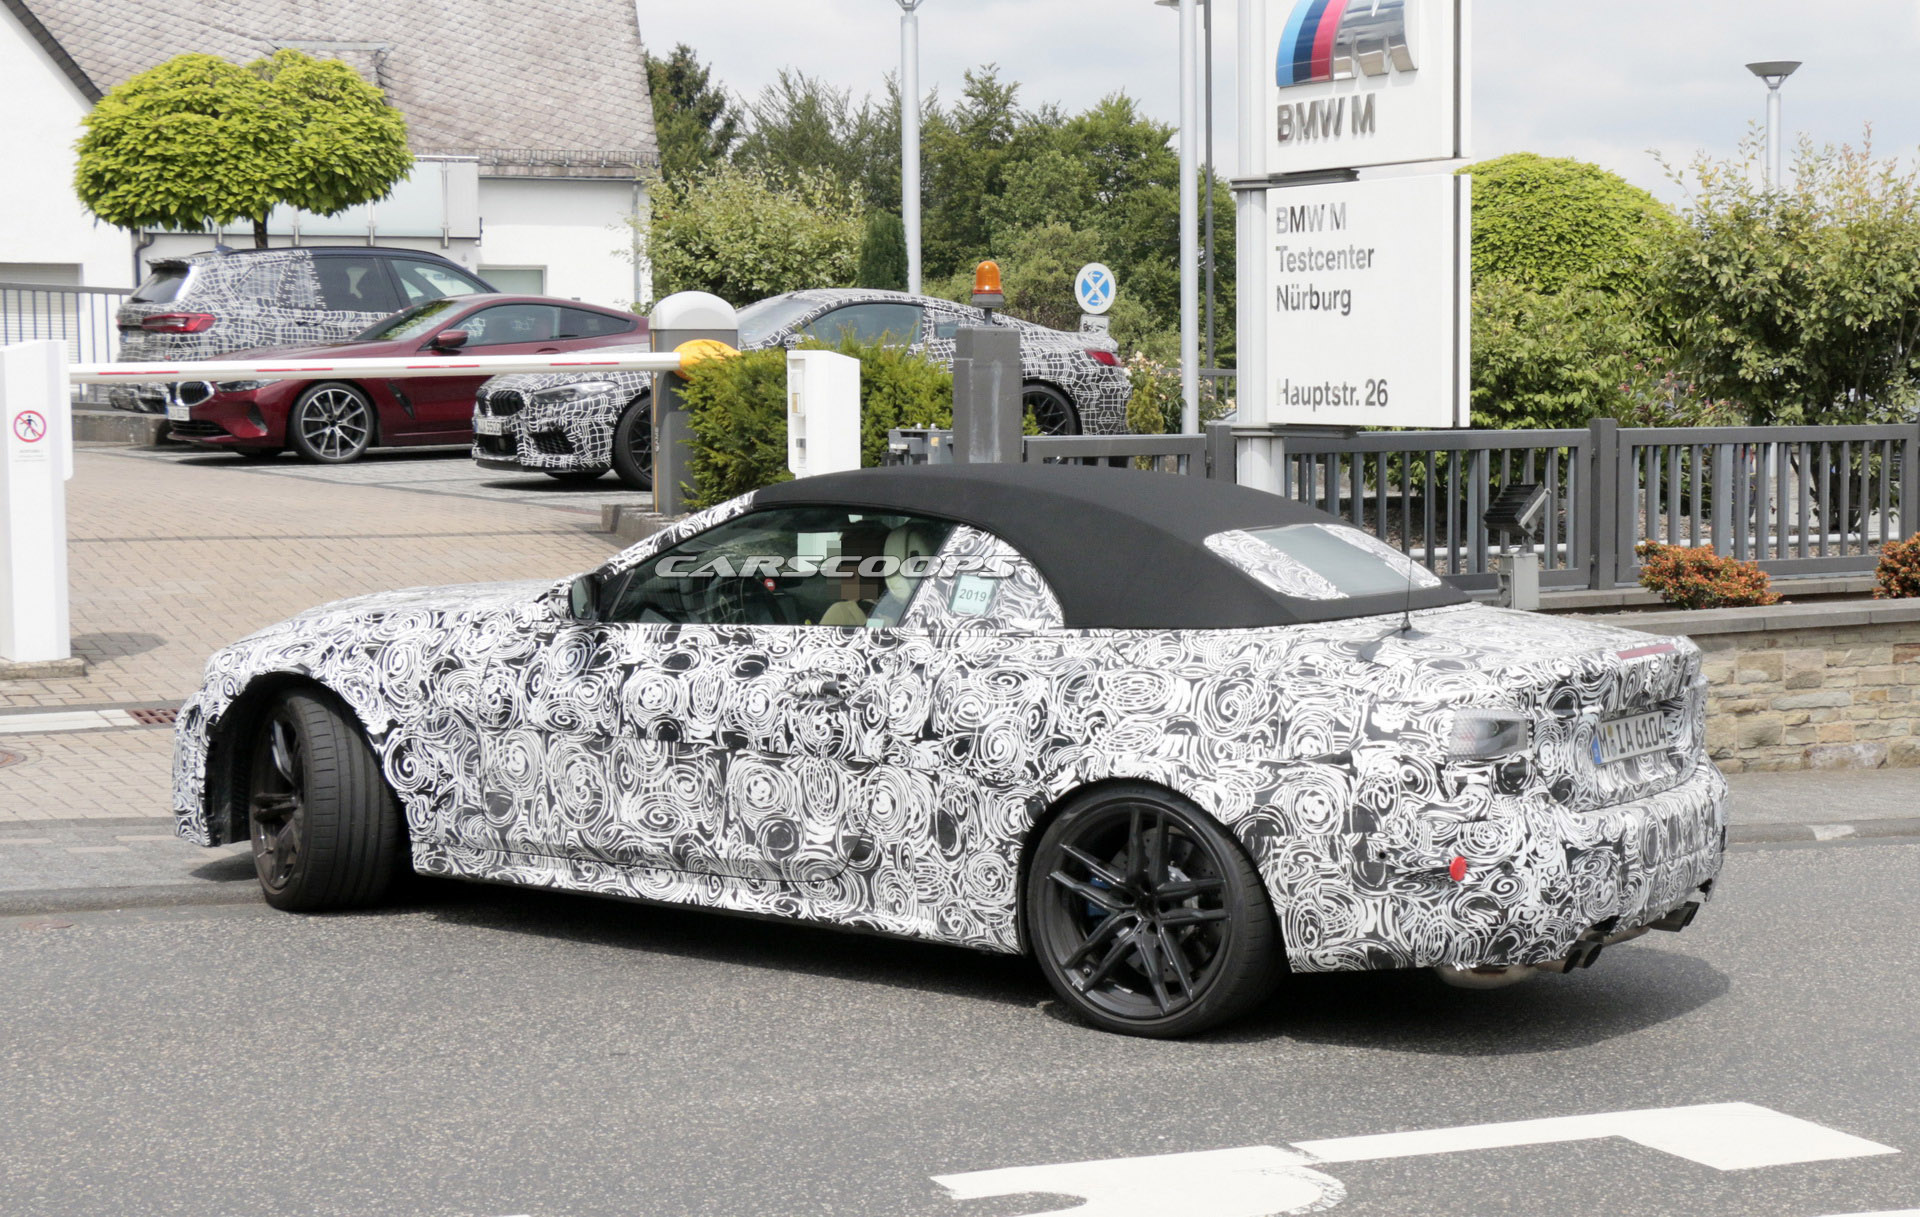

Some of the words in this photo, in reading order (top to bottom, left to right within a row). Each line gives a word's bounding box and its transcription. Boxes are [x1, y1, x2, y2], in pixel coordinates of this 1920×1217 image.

[1277, 97, 1345, 142] BMW
[1351, 93, 1376, 135] M
[1276, 204, 1325, 234] BMW
[1330, 202, 1347, 231] M
[1275, 244, 1375, 273] Testcenter
[1276, 283, 1352, 317] Nürburg
[1276, 378, 1360, 413] Hauptstr.
[1365, 378, 1389, 407] 26
[958, 588, 988, 602] 2019
[1597, 727, 1610, 758] M
[1615, 722, 1635, 754] IA
[1635, 714, 1667, 750] 6104
